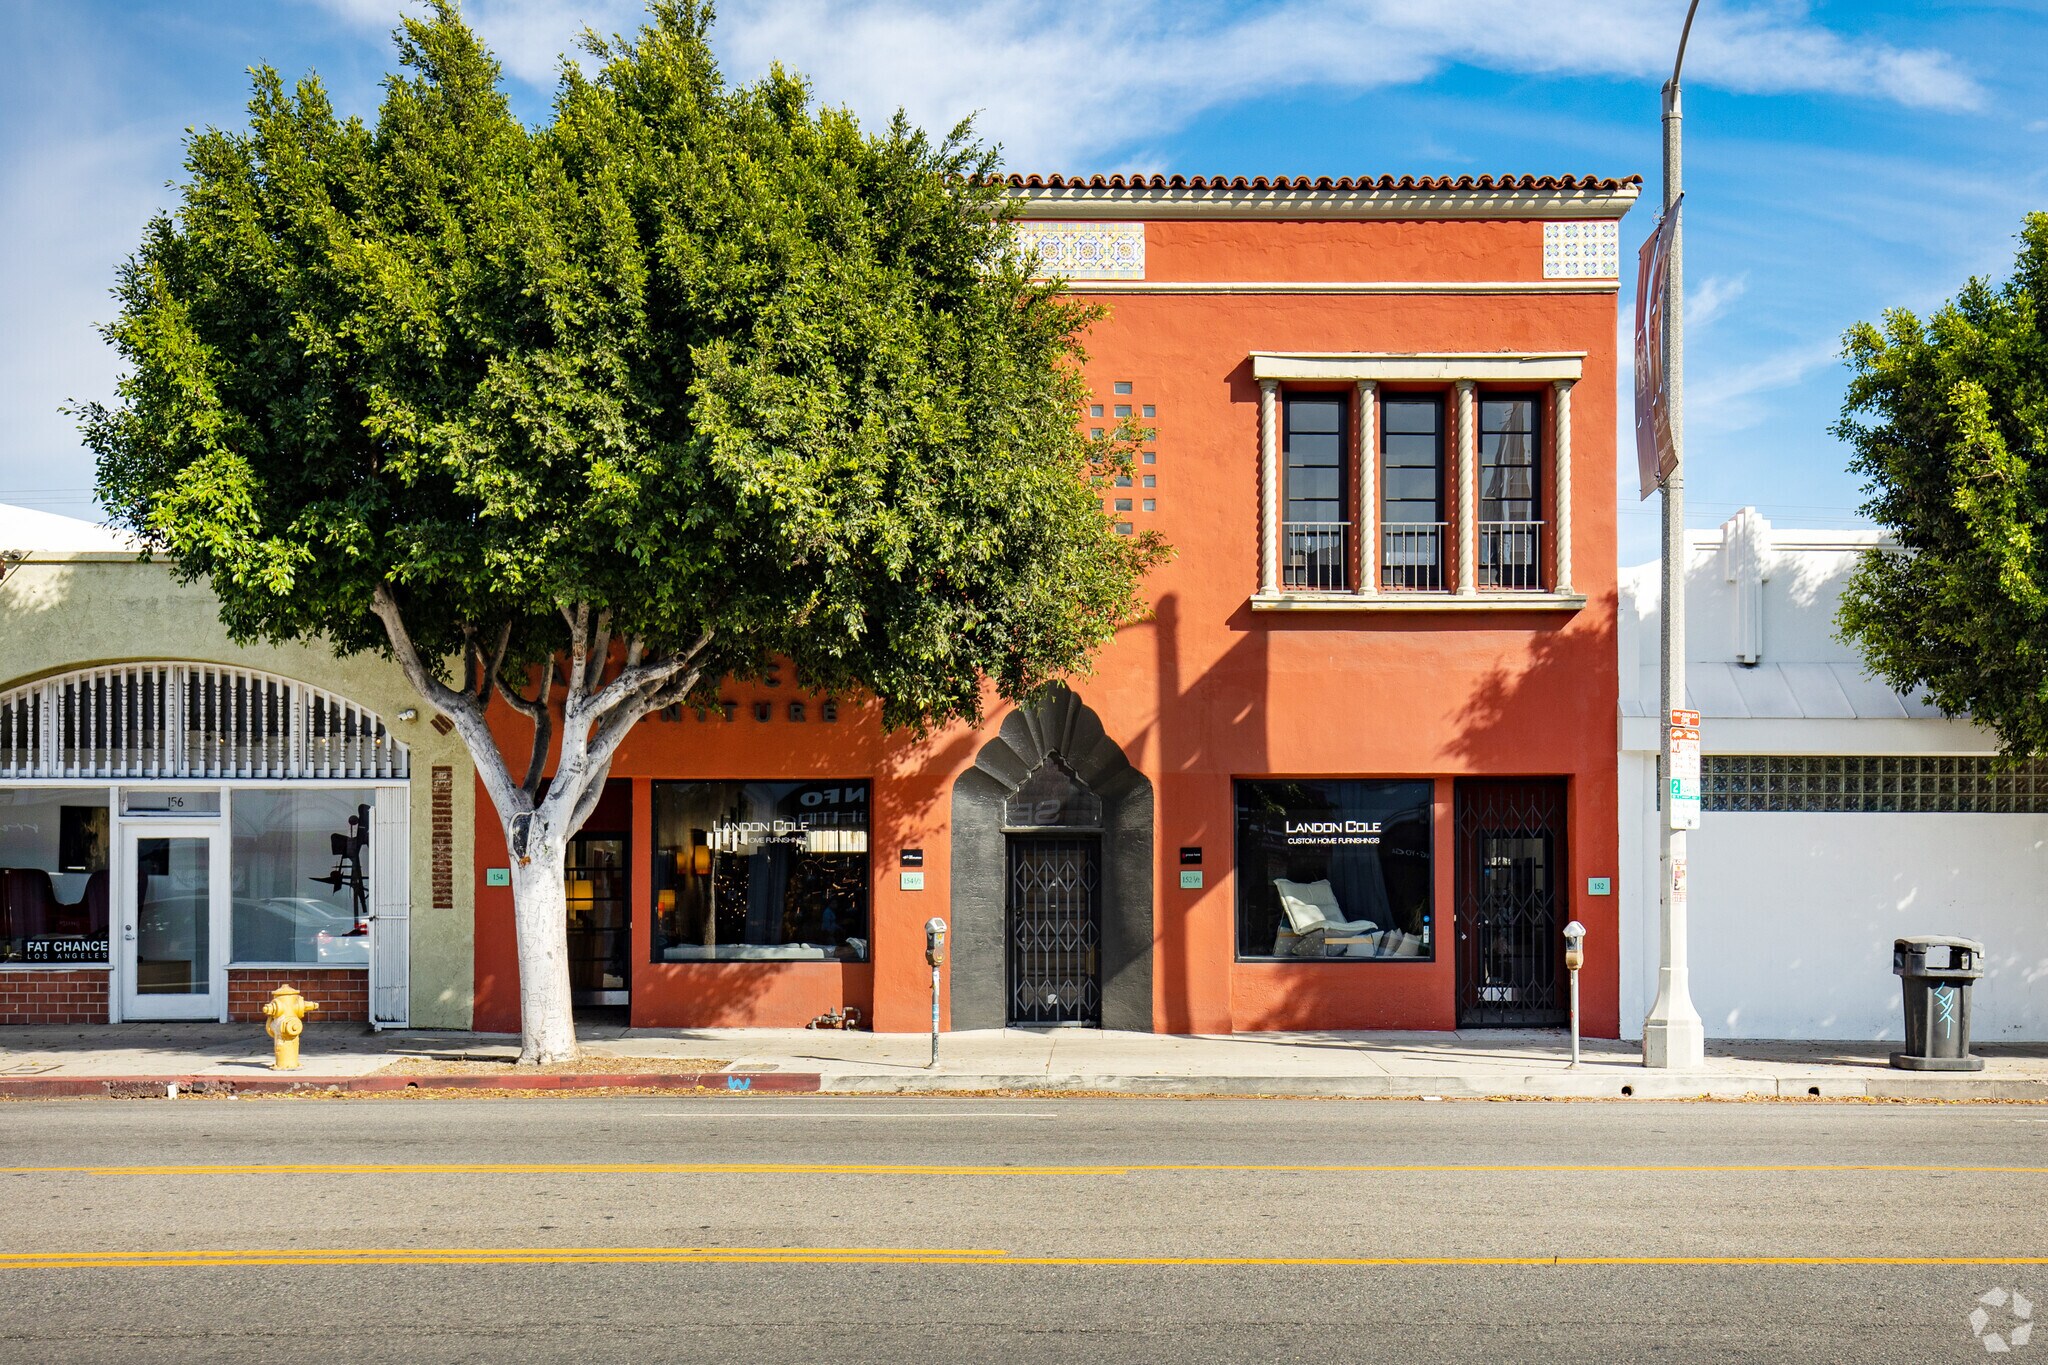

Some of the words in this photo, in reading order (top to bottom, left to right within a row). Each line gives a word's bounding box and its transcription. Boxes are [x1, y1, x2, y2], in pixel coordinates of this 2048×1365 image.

[1672, 780, 1679, 793] 2
[168, 797, 184, 807] 156
[713, 820, 770, 832] LANDON
[773, 820, 809, 832] COLE
[1286, 821, 1342, 833] LANDON
[1345, 821, 1381, 833] COLE
[1594, 882, 1605, 890] 152
[27, 941, 50, 952] FAT
[53, 940, 108, 952] CHANCE
